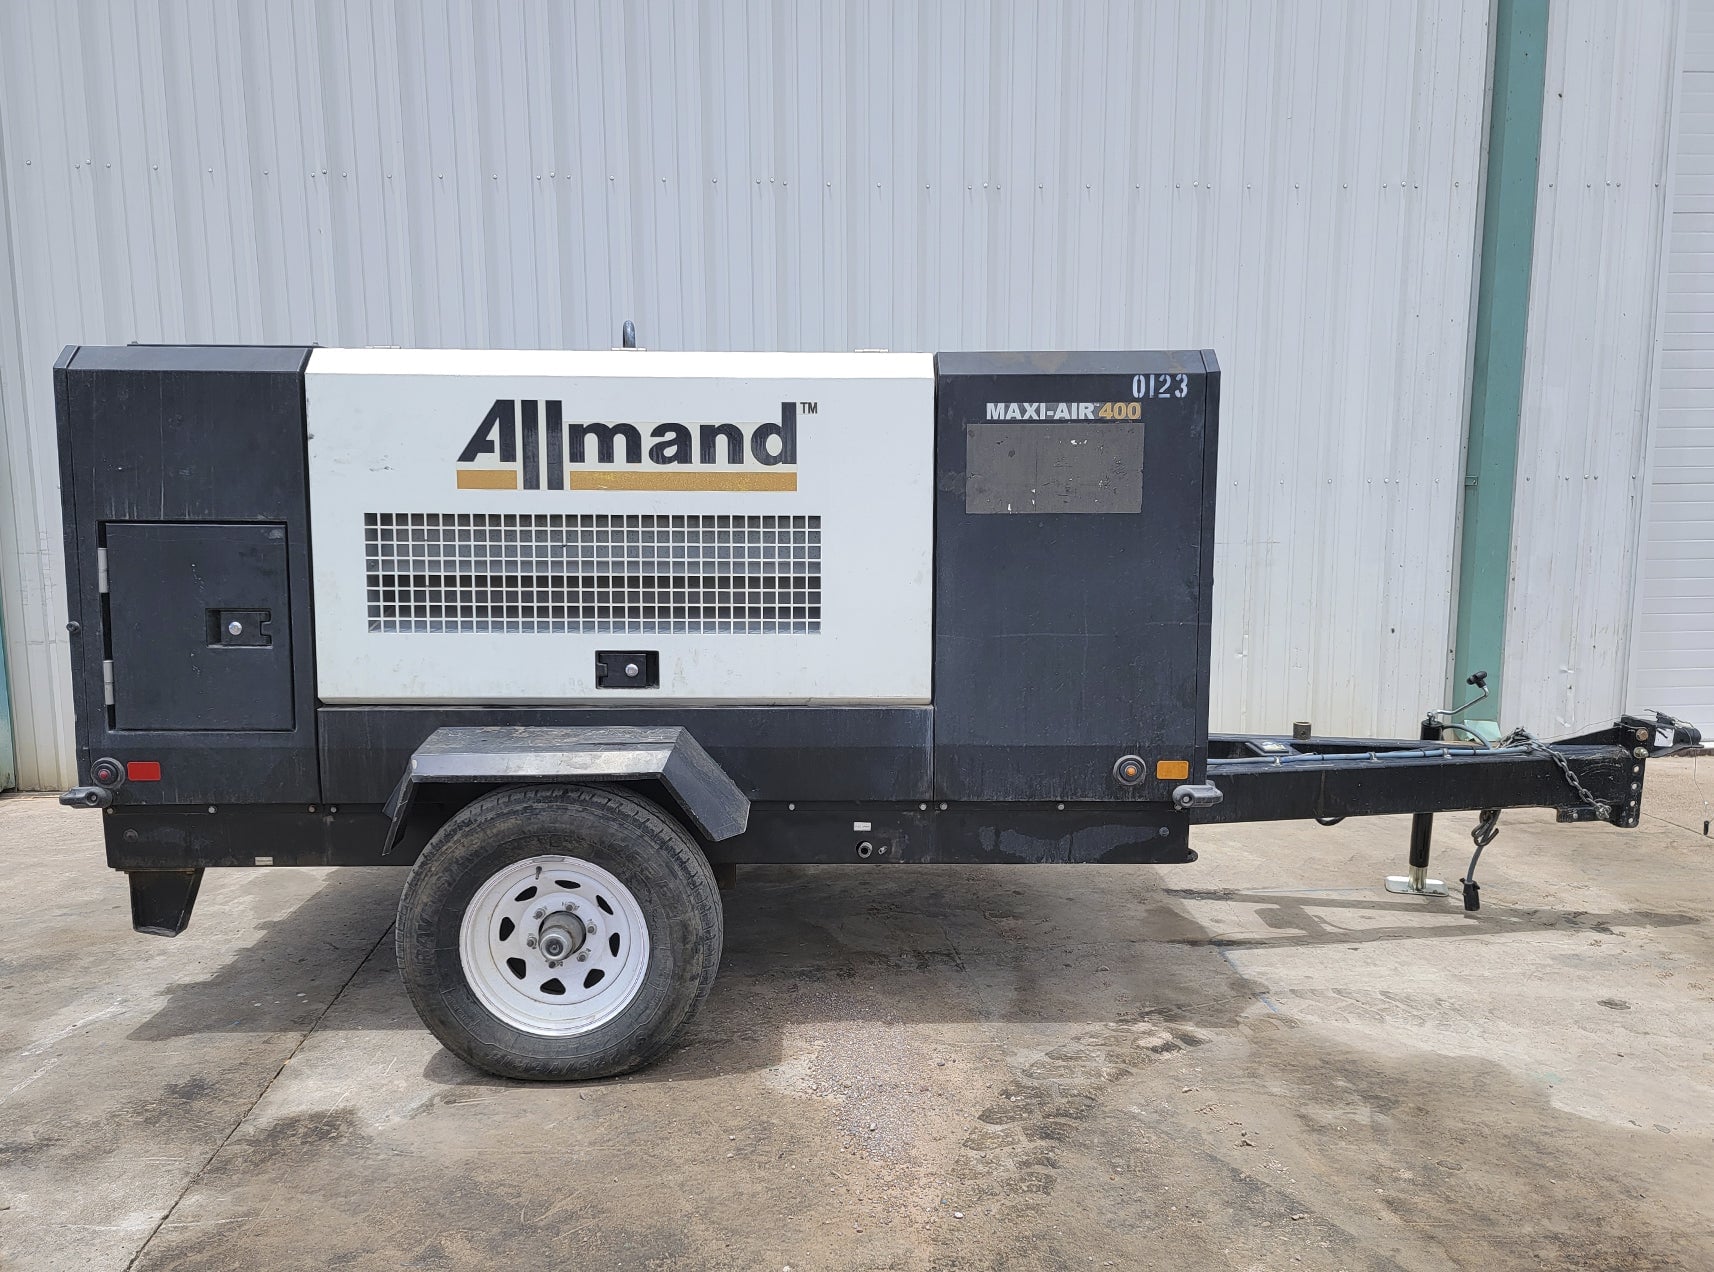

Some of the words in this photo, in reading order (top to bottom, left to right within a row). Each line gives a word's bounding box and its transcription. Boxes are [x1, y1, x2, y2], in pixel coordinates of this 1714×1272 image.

[1132, 373, 1188, 398] 0123
[986, 402, 1094, 419] MAXI-AIR
[1098, 402, 1141, 419] 400
[457, 399, 797, 489] Allmand
